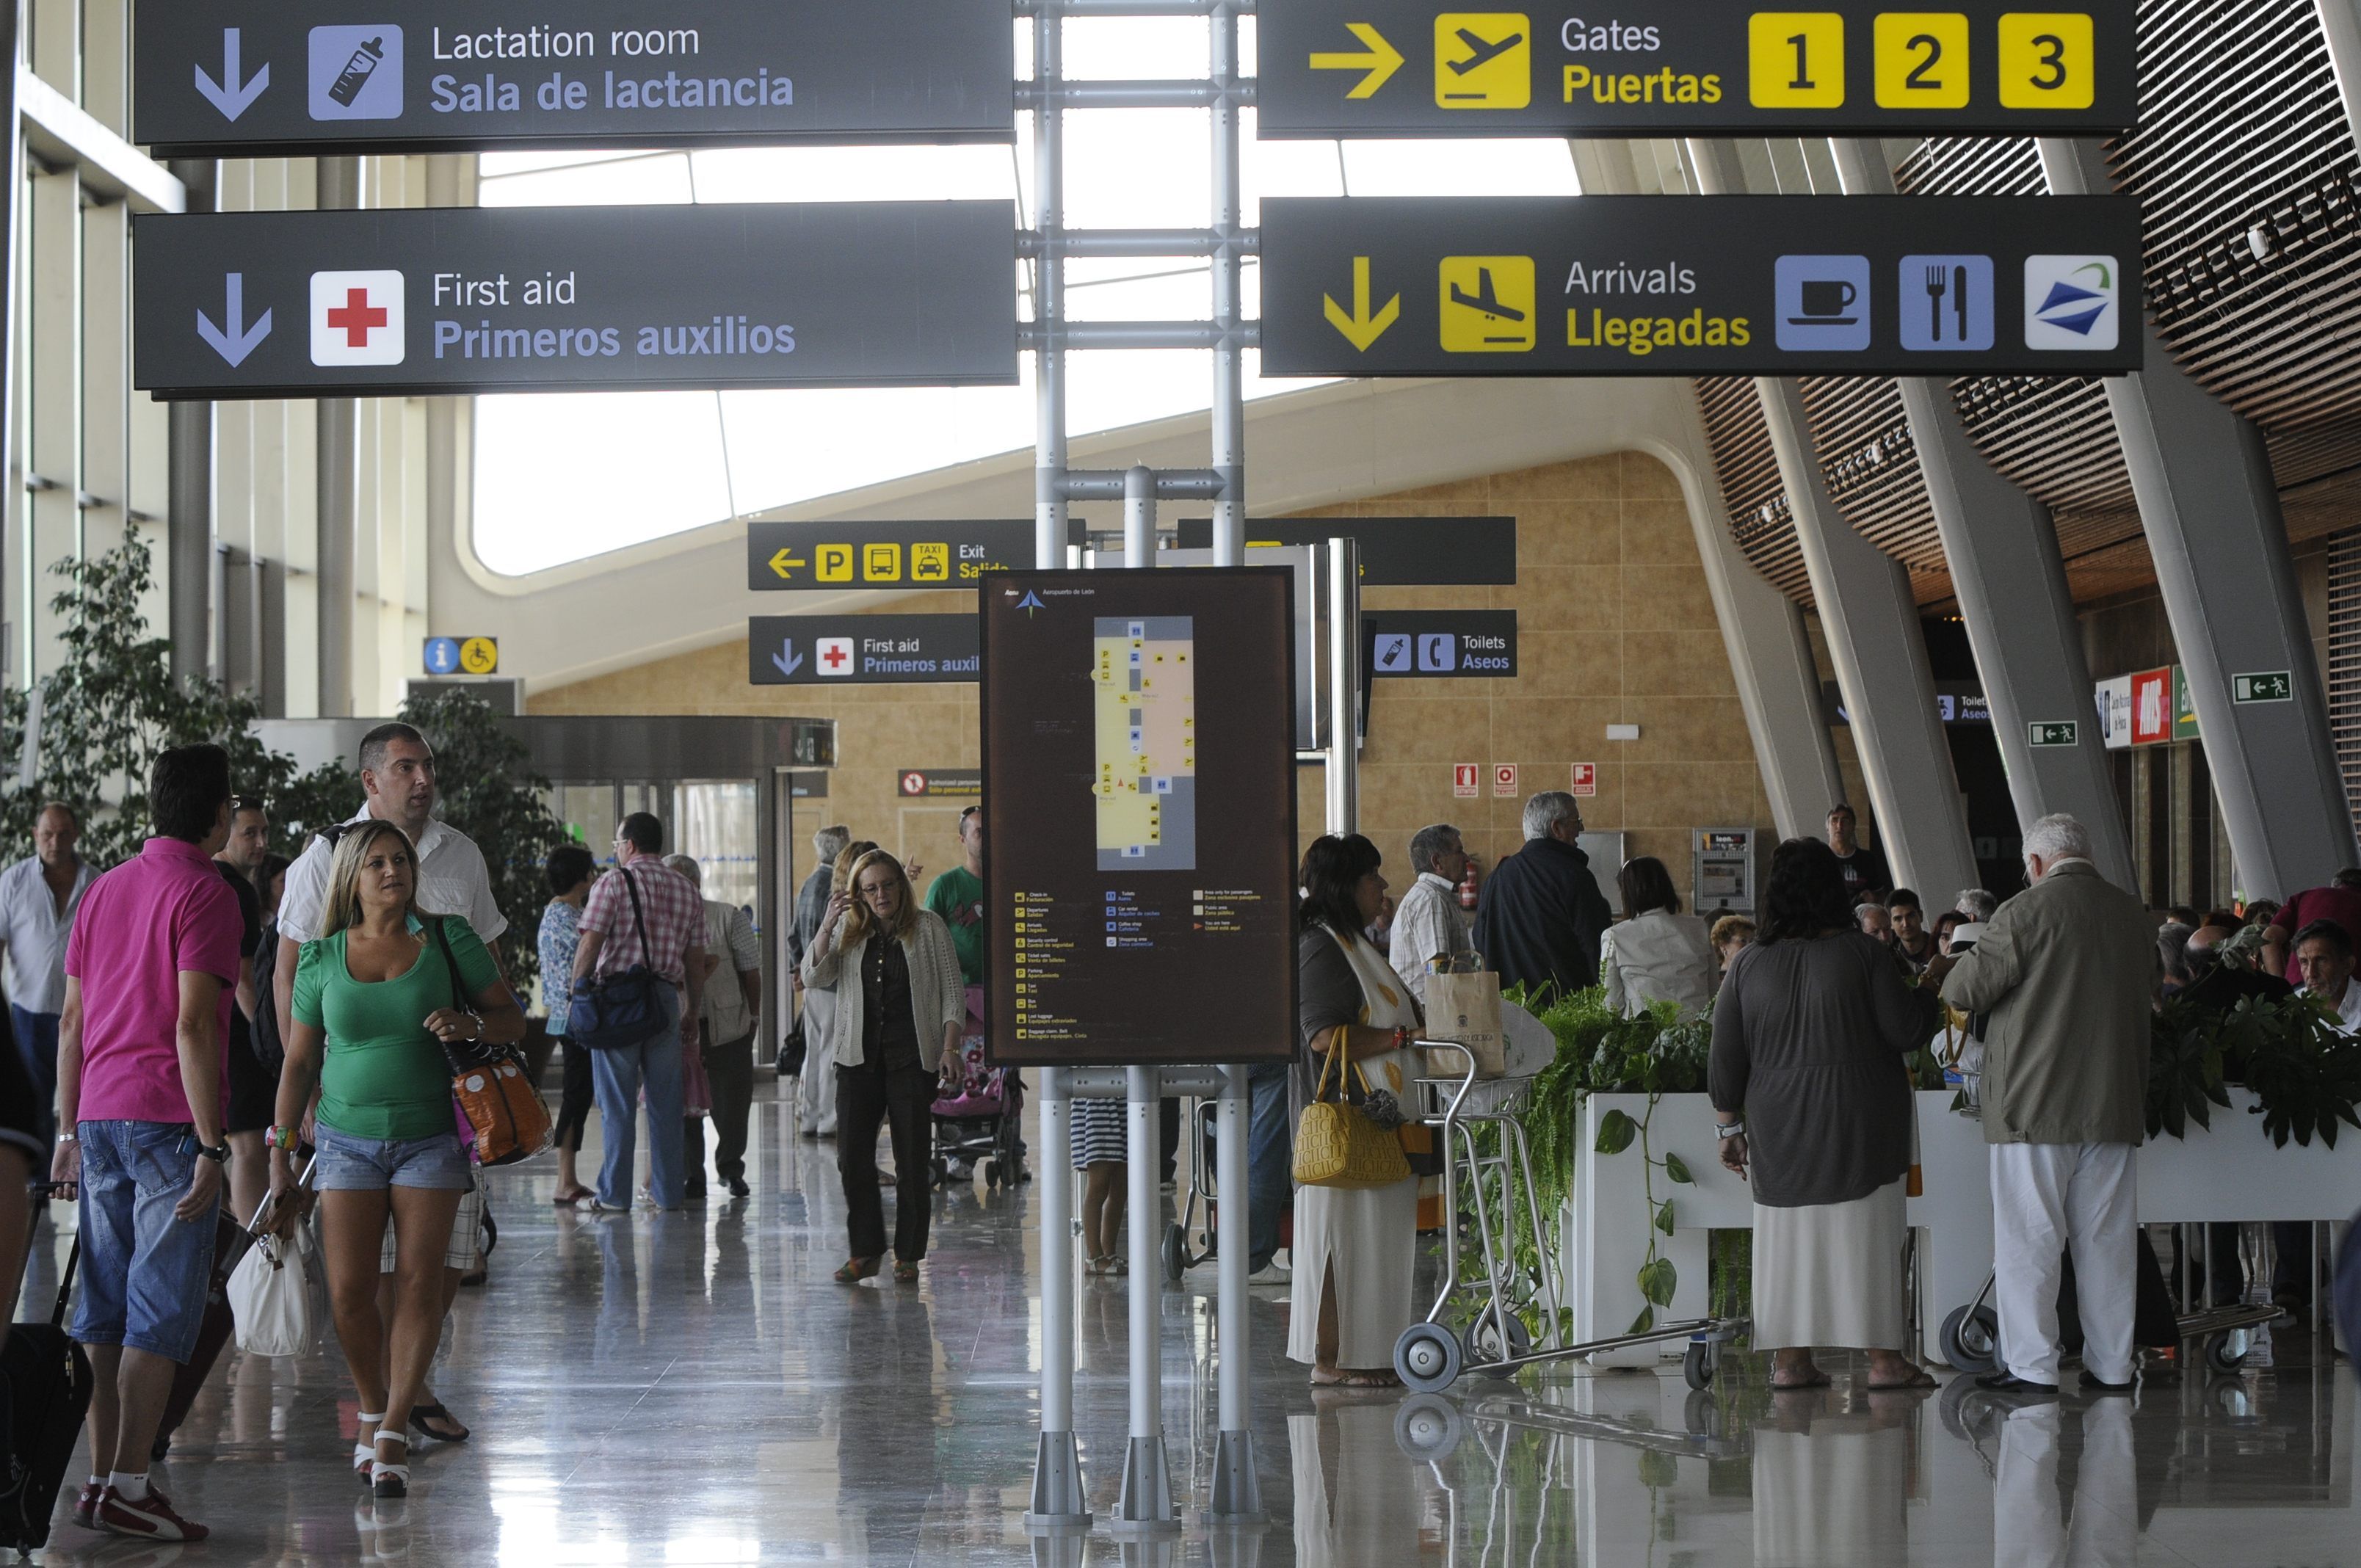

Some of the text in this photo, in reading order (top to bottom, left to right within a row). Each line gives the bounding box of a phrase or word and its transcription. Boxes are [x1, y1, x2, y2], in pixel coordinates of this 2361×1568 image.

[435, 25, 698, 59] Lactation room
[1562, 18, 1660, 51] Gates
[1788, 34, 2066, 90] 1 2 3
[431, 68, 793, 112] Sala de lactancia
[1564, 65, 1721, 103] Puertas
[435, 272, 574, 306] First aid
[1565, 262, 1695, 293] Arrivals
[435, 316, 795, 358] Primeros auxilios
[1567, 308, 1749, 355] Llegadas
[959, 544, 985, 559] Exit
[864, 639, 919, 652] First aid
[1463, 636, 1505, 648] Toilets
[865, 657, 936, 672] Primeros
[1462, 654, 1509, 669] Aseos
[1961, 695, 1988, 707] Toilet
[2139, 678, 2162, 736] AVIS
